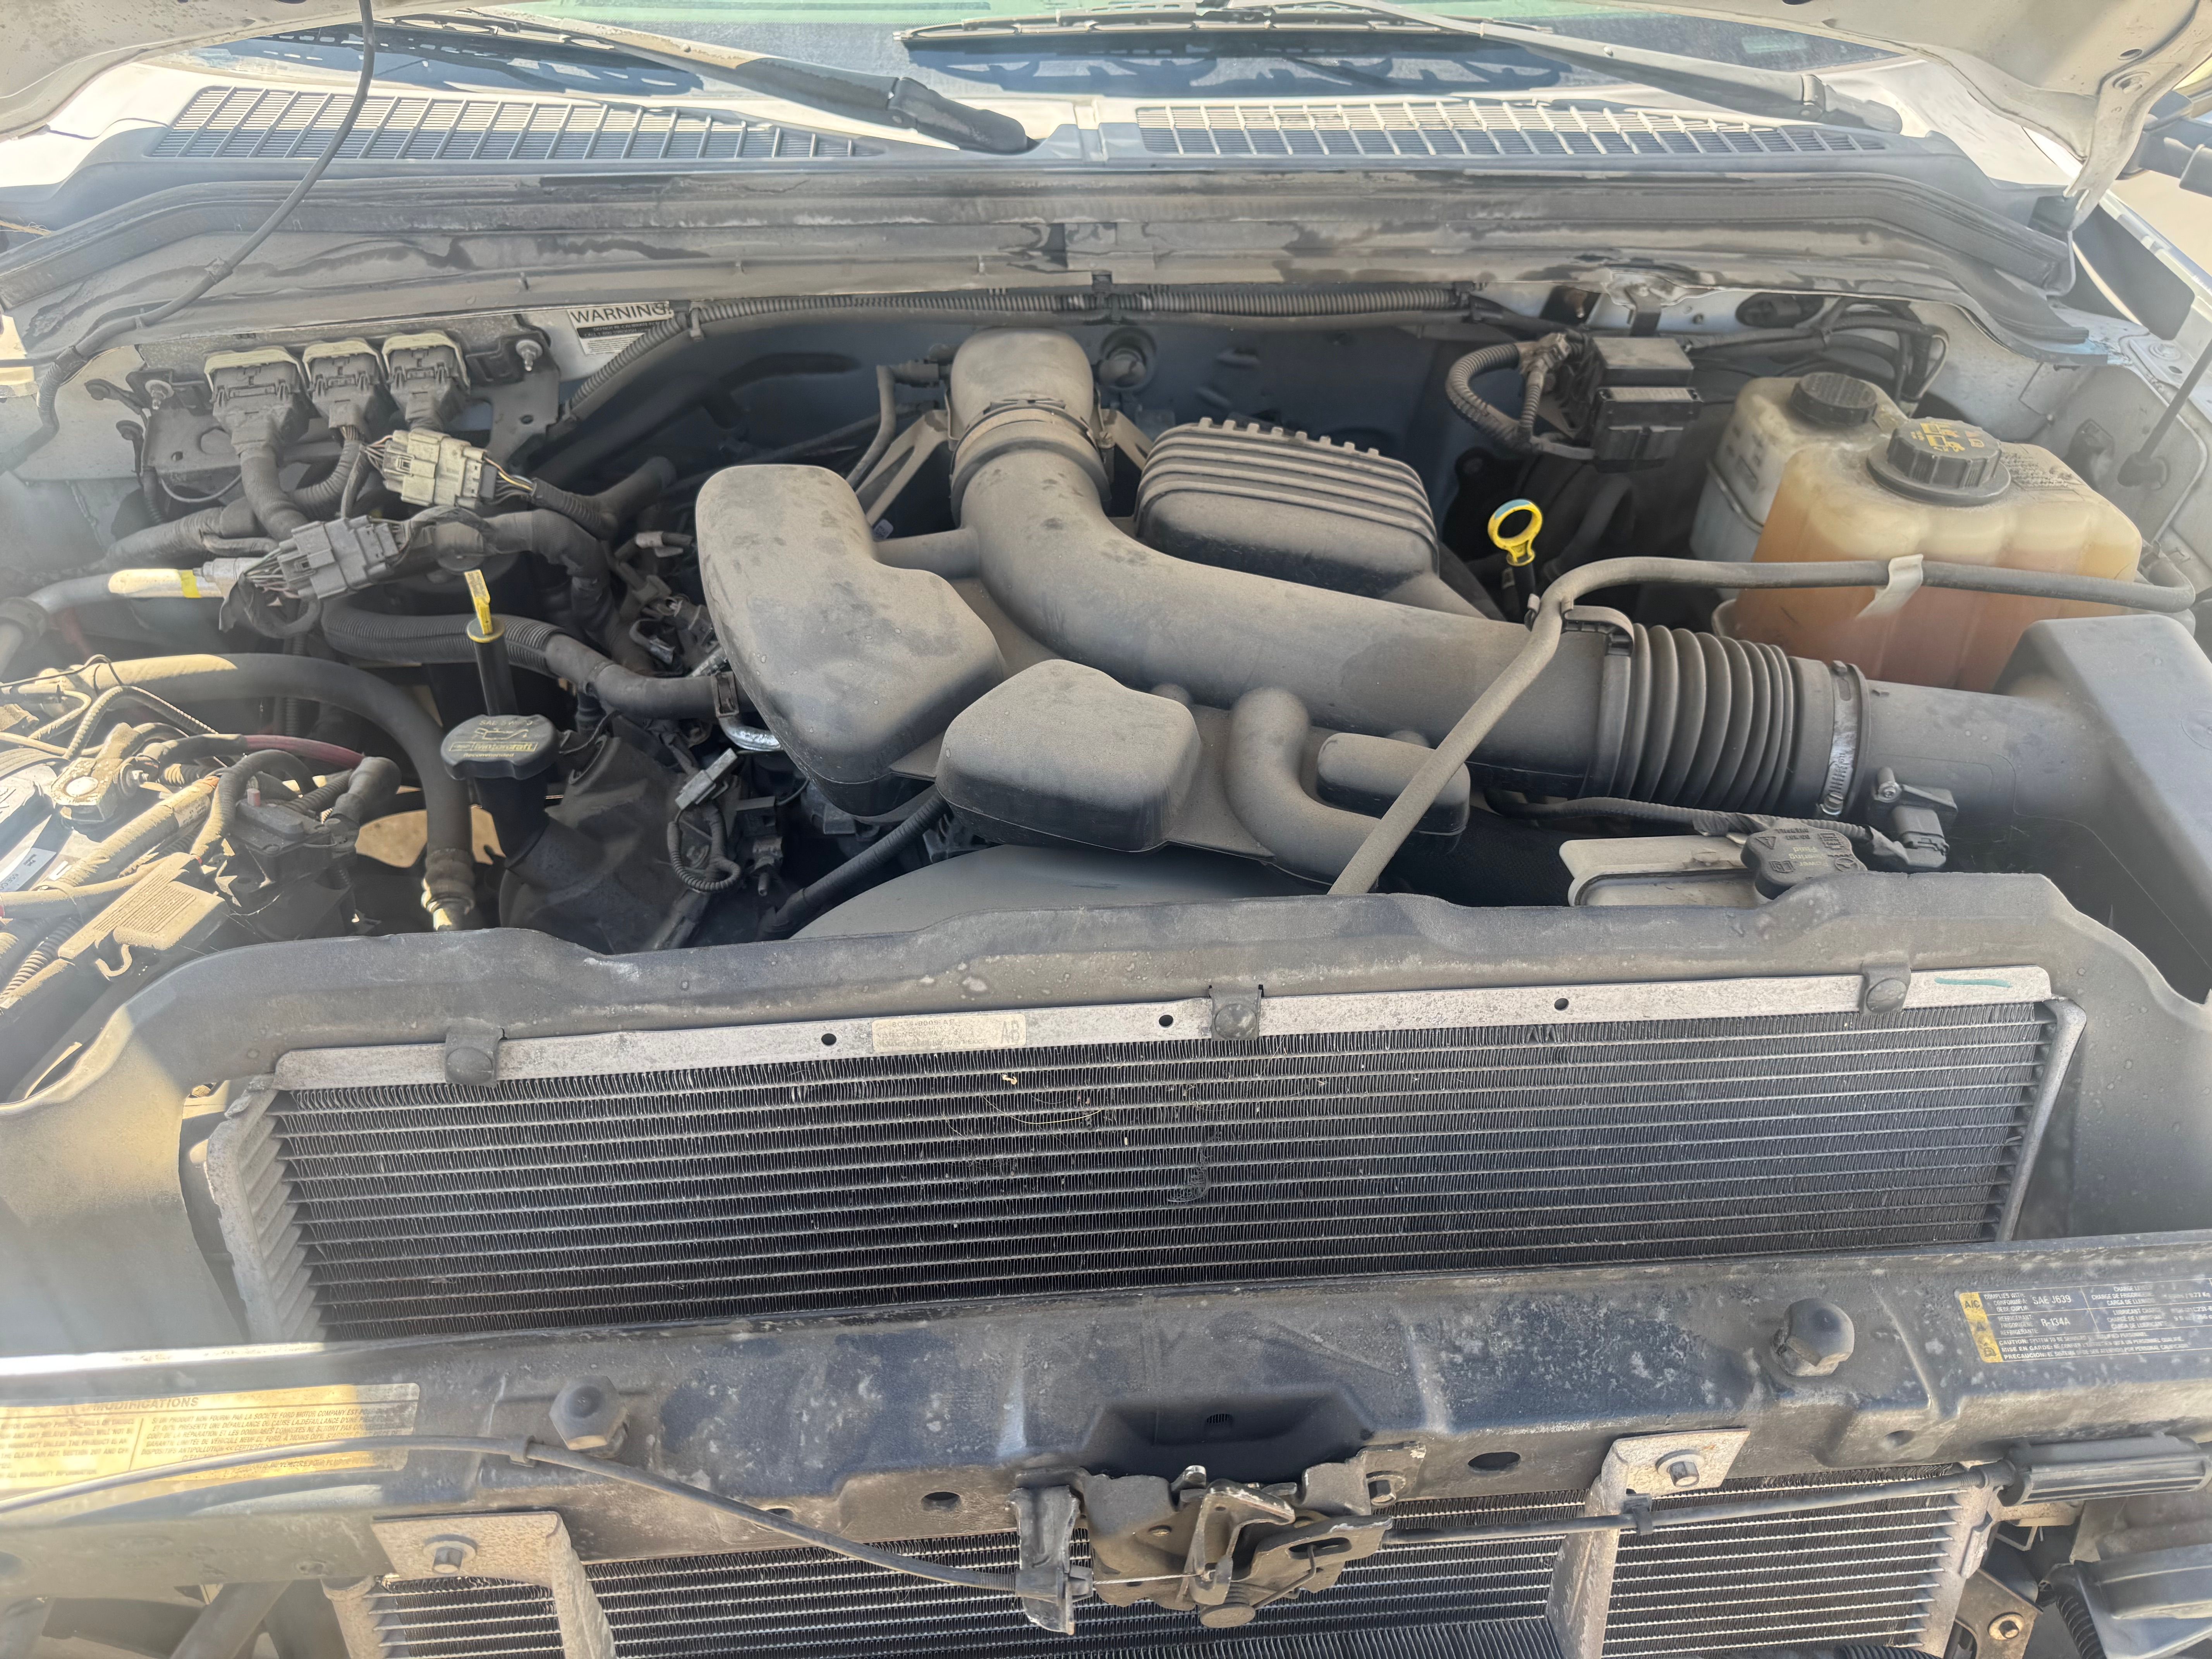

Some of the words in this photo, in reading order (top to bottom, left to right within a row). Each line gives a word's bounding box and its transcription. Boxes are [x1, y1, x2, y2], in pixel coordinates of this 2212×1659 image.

[2032, 1296, 2050, 1305] SAE
[2051, 1294, 2072, 1304] J639
[2040, 1317, 2070, 1327] R-134A
